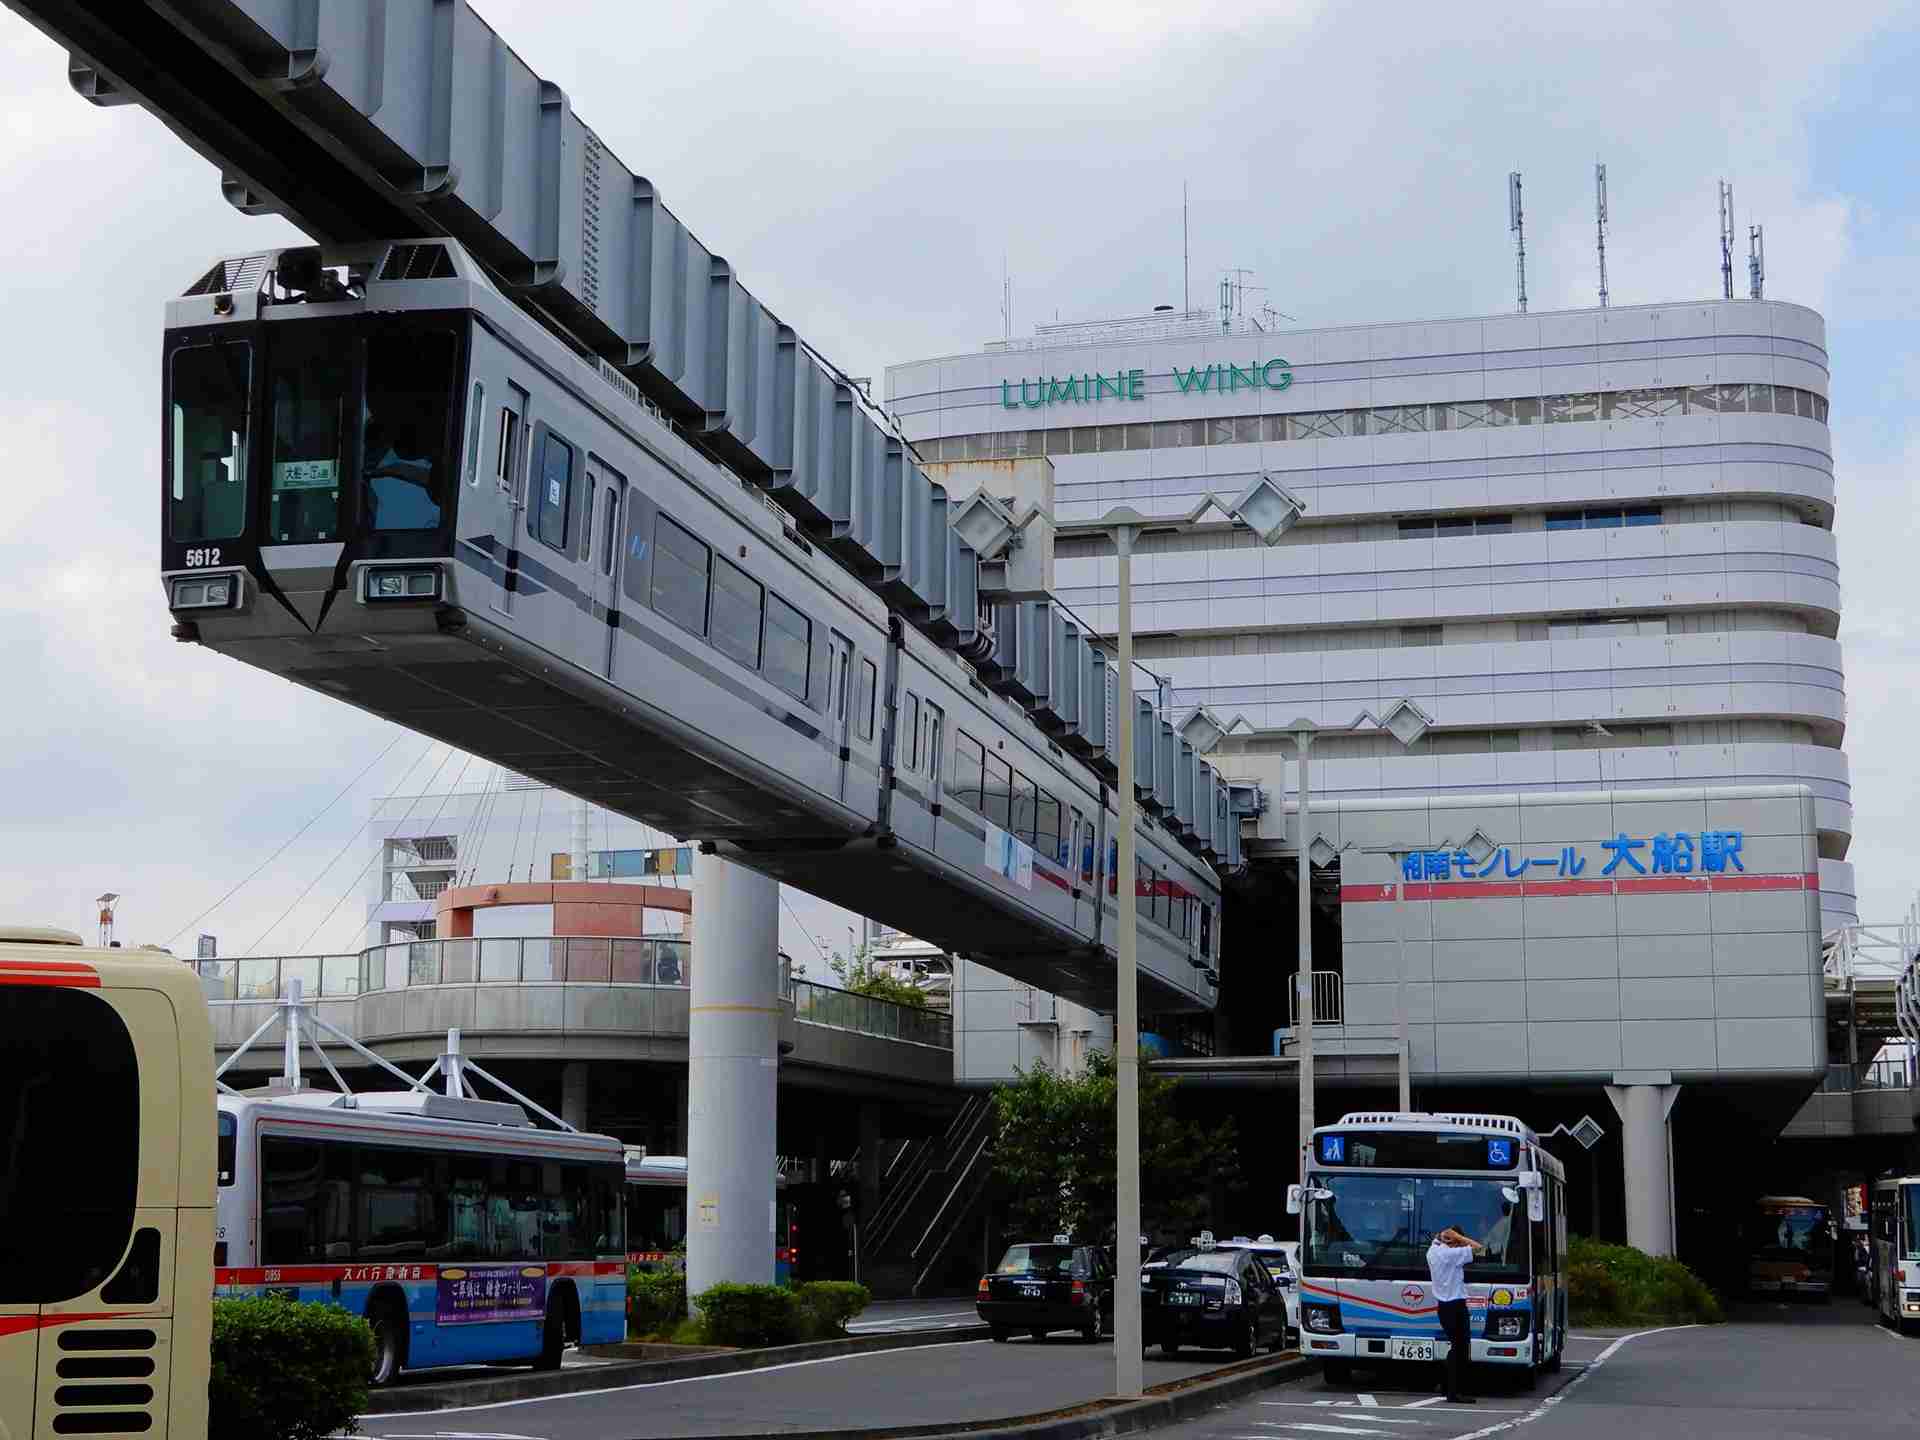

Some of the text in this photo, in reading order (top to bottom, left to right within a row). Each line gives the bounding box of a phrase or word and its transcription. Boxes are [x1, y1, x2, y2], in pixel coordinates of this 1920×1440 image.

[1001, 358, 1294, 410] LUMINE WING
[185, 547, 221, 568] 5612
[1600, 831, 1745, 876] 大船駅
